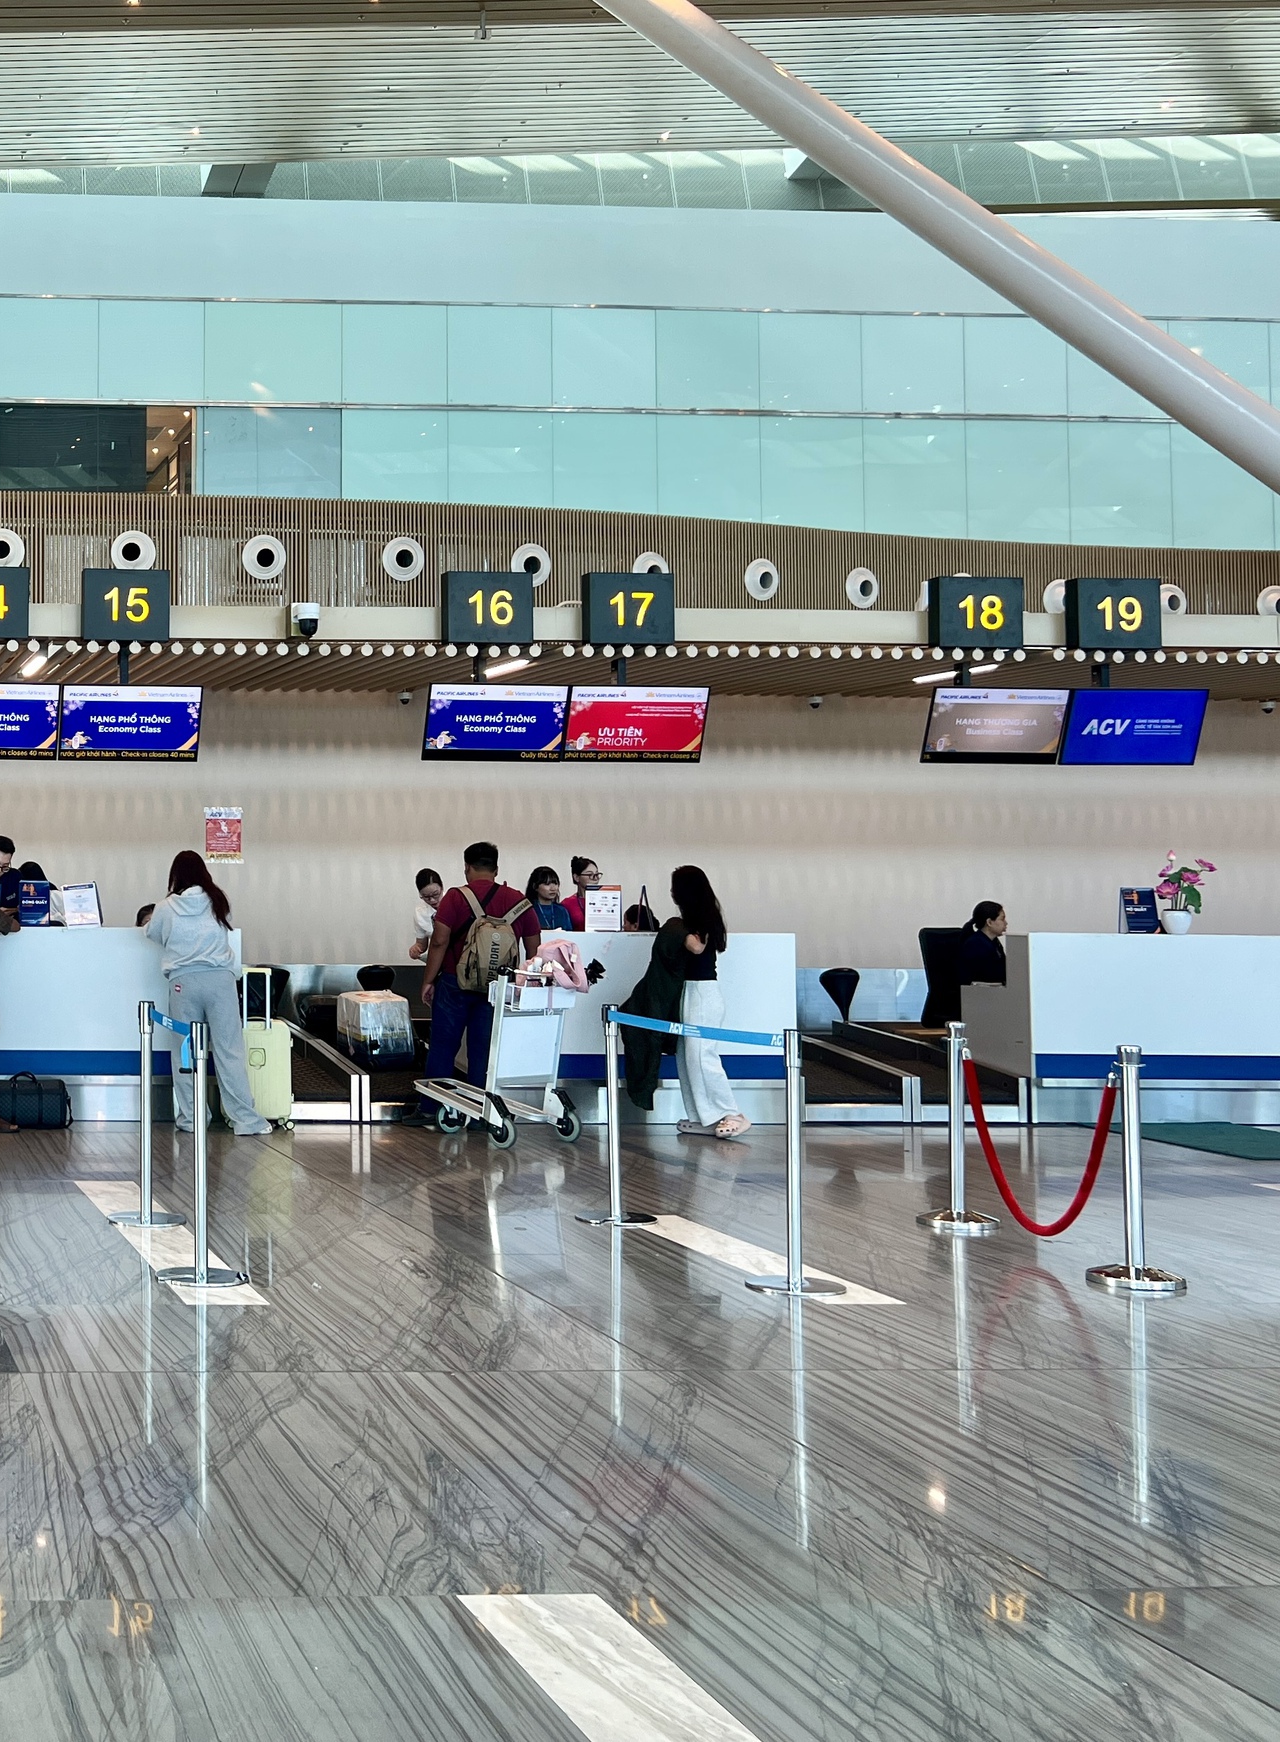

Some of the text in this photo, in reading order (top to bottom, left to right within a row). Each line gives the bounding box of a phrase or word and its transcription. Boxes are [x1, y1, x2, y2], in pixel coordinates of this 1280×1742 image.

[104, 587, 150, 622] 15
[469, 590, 514, 625] 16
[609, 591, 654, 627] 17
[958, 594, 1004, 630] 18
[1097, 596, 1142, 631] 19
[90, 712, 171, 724] HẠNG PHỔ THÔNG
[456, 712, 536, 724] HẠNG PHỔ THÔNG
[956, 718, 981, 727] HẠNG
[98, 725, 137, 734] Economy
[464, 725, 502, 733] Economy
[618, 726, 642, 737] TIÊN
[1081, 719, 1131, 735] ACV
[597, 738, 647, 746] PRIORITY
[669, 1022, 683, 1035] ACV
[771, 1034, 783, 1046] AC
